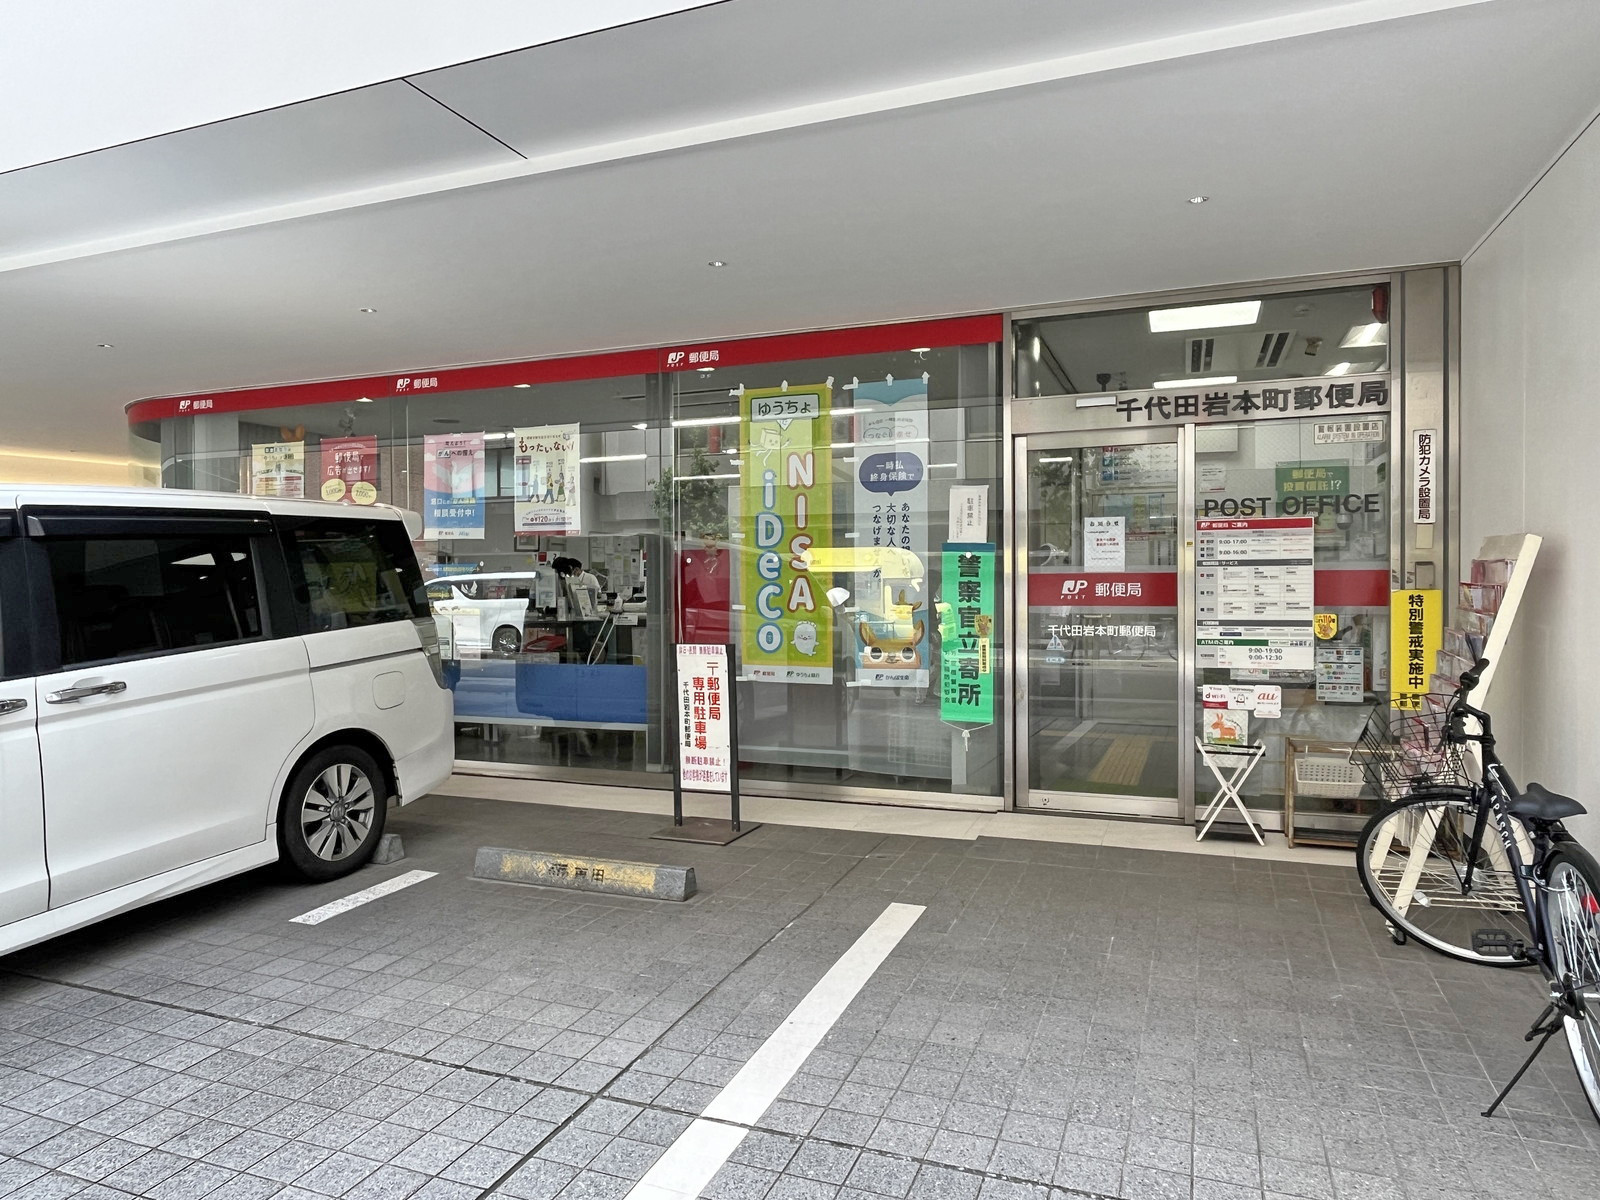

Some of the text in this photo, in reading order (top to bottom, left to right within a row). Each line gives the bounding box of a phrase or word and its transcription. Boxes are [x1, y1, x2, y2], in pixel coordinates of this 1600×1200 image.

[688, 350, 719, 364] 郵便局
[413, 377, 438, 389] 郵便局
[192, 399, 213, 410] 郵便局
[758, 400, 811, 416] ゆうちょ
[1116, 380, 1390, 422] 千代田岩本町郵便局
[876, 460, 904, 470] 一時払
[870, 471, 915, 482] 終身保険で
[1418, 434, 1431, 519] 防犯カメラ設置局
[1204, 493, 1380, 517] POST OFFICE
[787, 451, 816, 613] NISA
[755, 468, 784, 653] iDeCo
[1095, 582, 1142, 597] 郵便局
[957, 553, 982, 706] 警察官立寄所
[1047, 624, 1156, 637] 千代田岩本町郵便局
[1408, 594, 1424, 689] 特別警戒実施中
[1257, 692, 1278, 701] au
[683, 681, 691, 748] 千代田岩本町郵便局
[692, 676, 707, 750] 専用駐車場
